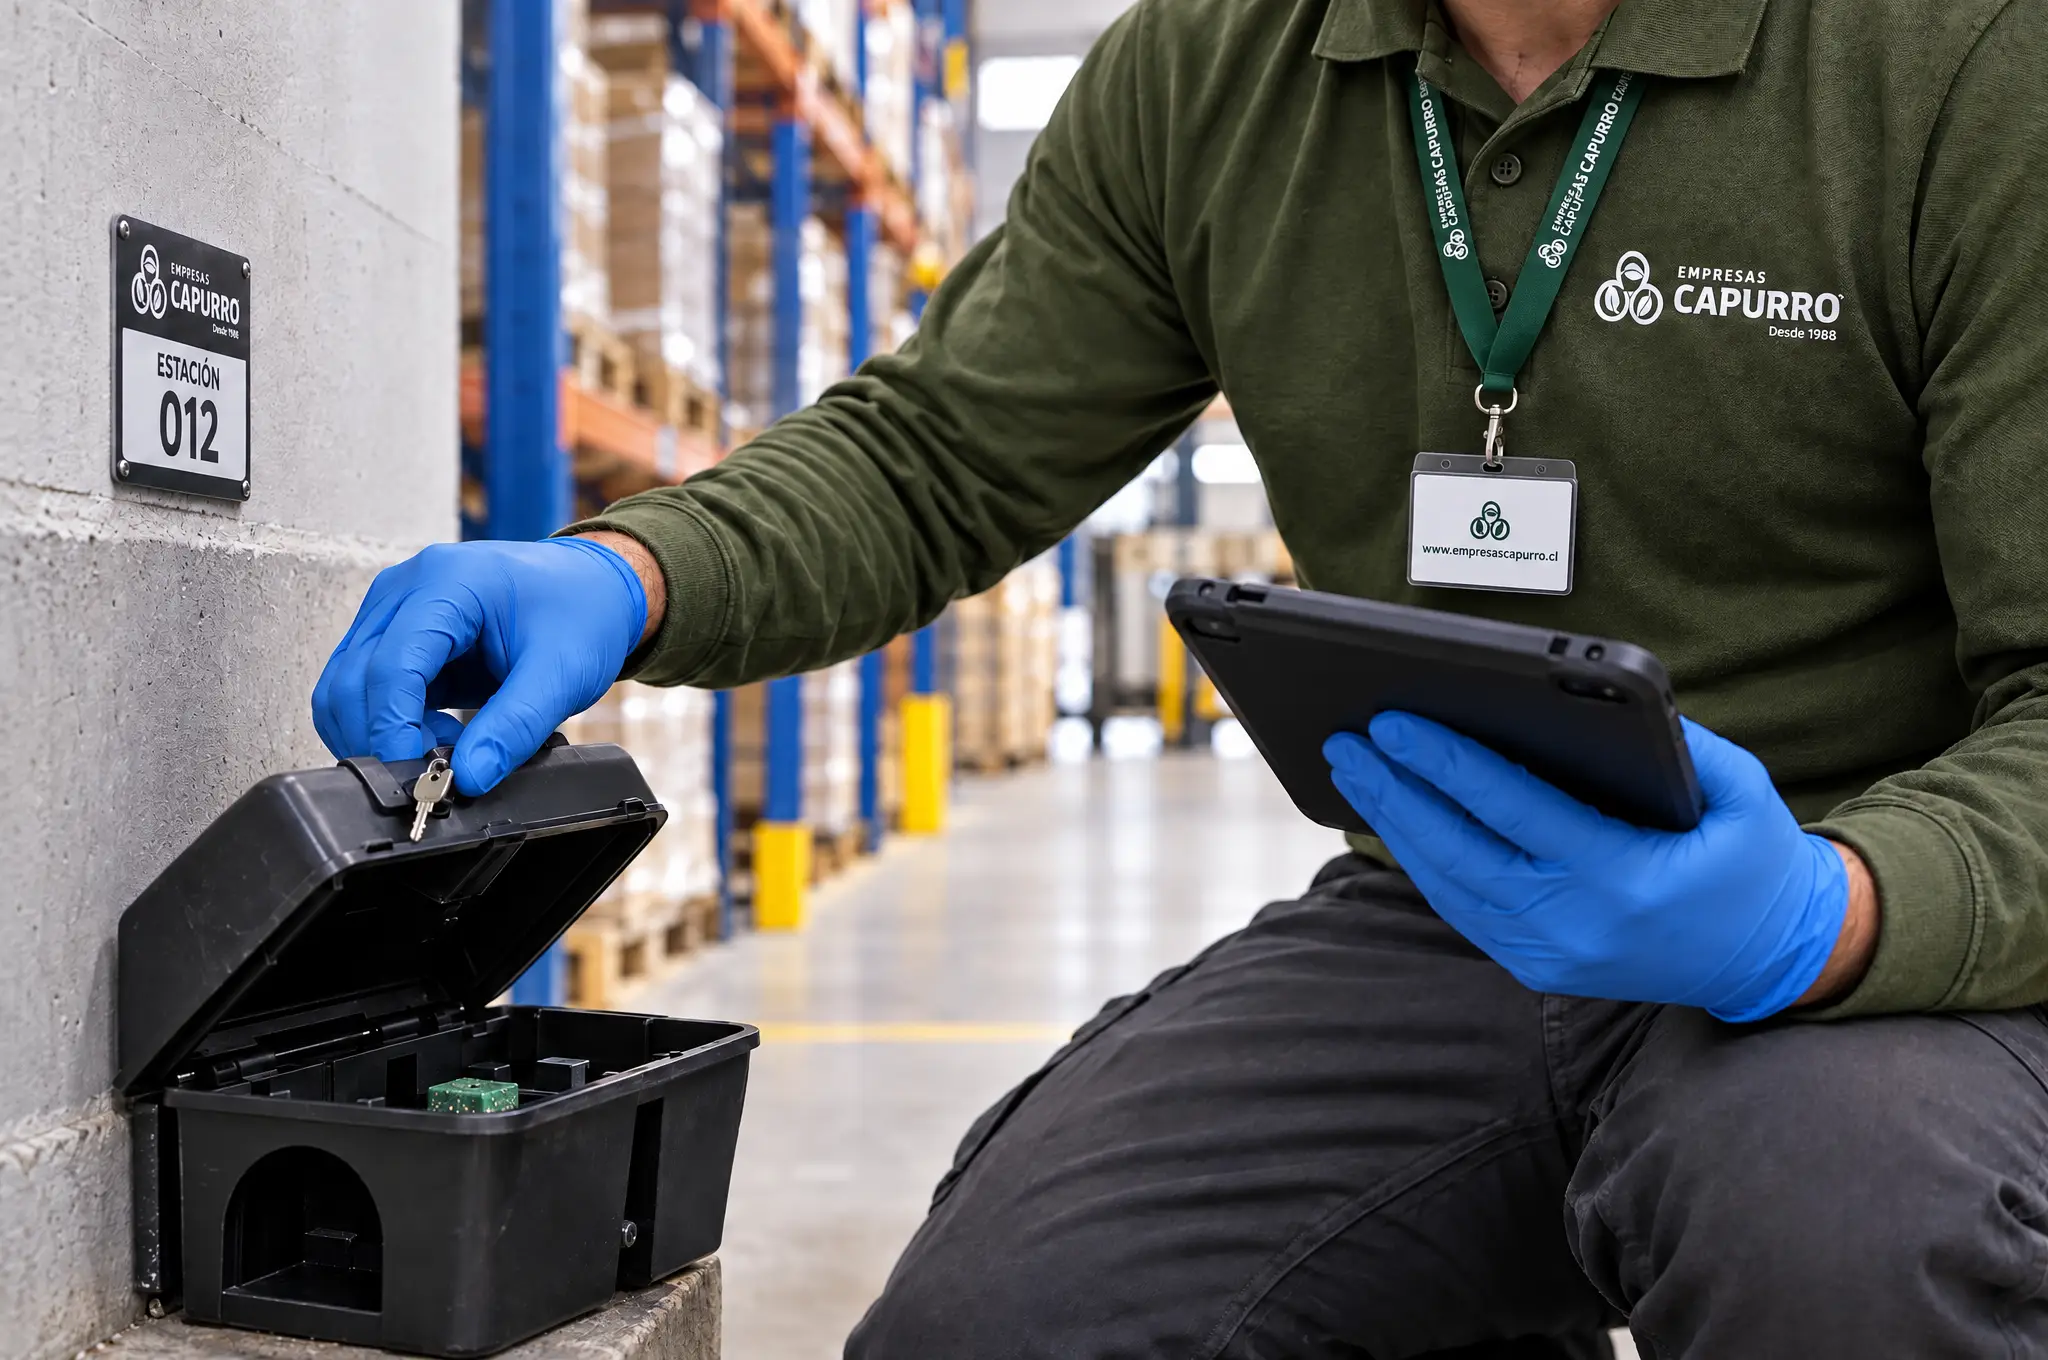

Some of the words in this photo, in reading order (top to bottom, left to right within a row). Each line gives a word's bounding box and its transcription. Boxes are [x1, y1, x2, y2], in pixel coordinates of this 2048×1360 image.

[1420, 98, 1444, 168] CAPURRO
[1580, 102, 1619, 173] CAPURRO
[1677, 265, 1766, 284] EMPRESAS
[170, 280, 240, 326] CAPURRO
[1673, 284, 1841, 324] CAPURRO
[1768, 325, 1805, 339] Desde
[1808, 328, 1837, 341] 1988
[157, 352, 220, 391] ESTACIÓN
[159, 390, 219, 464] 012
[1422, 544, 1559, 563] www.empresascapurro.cl
